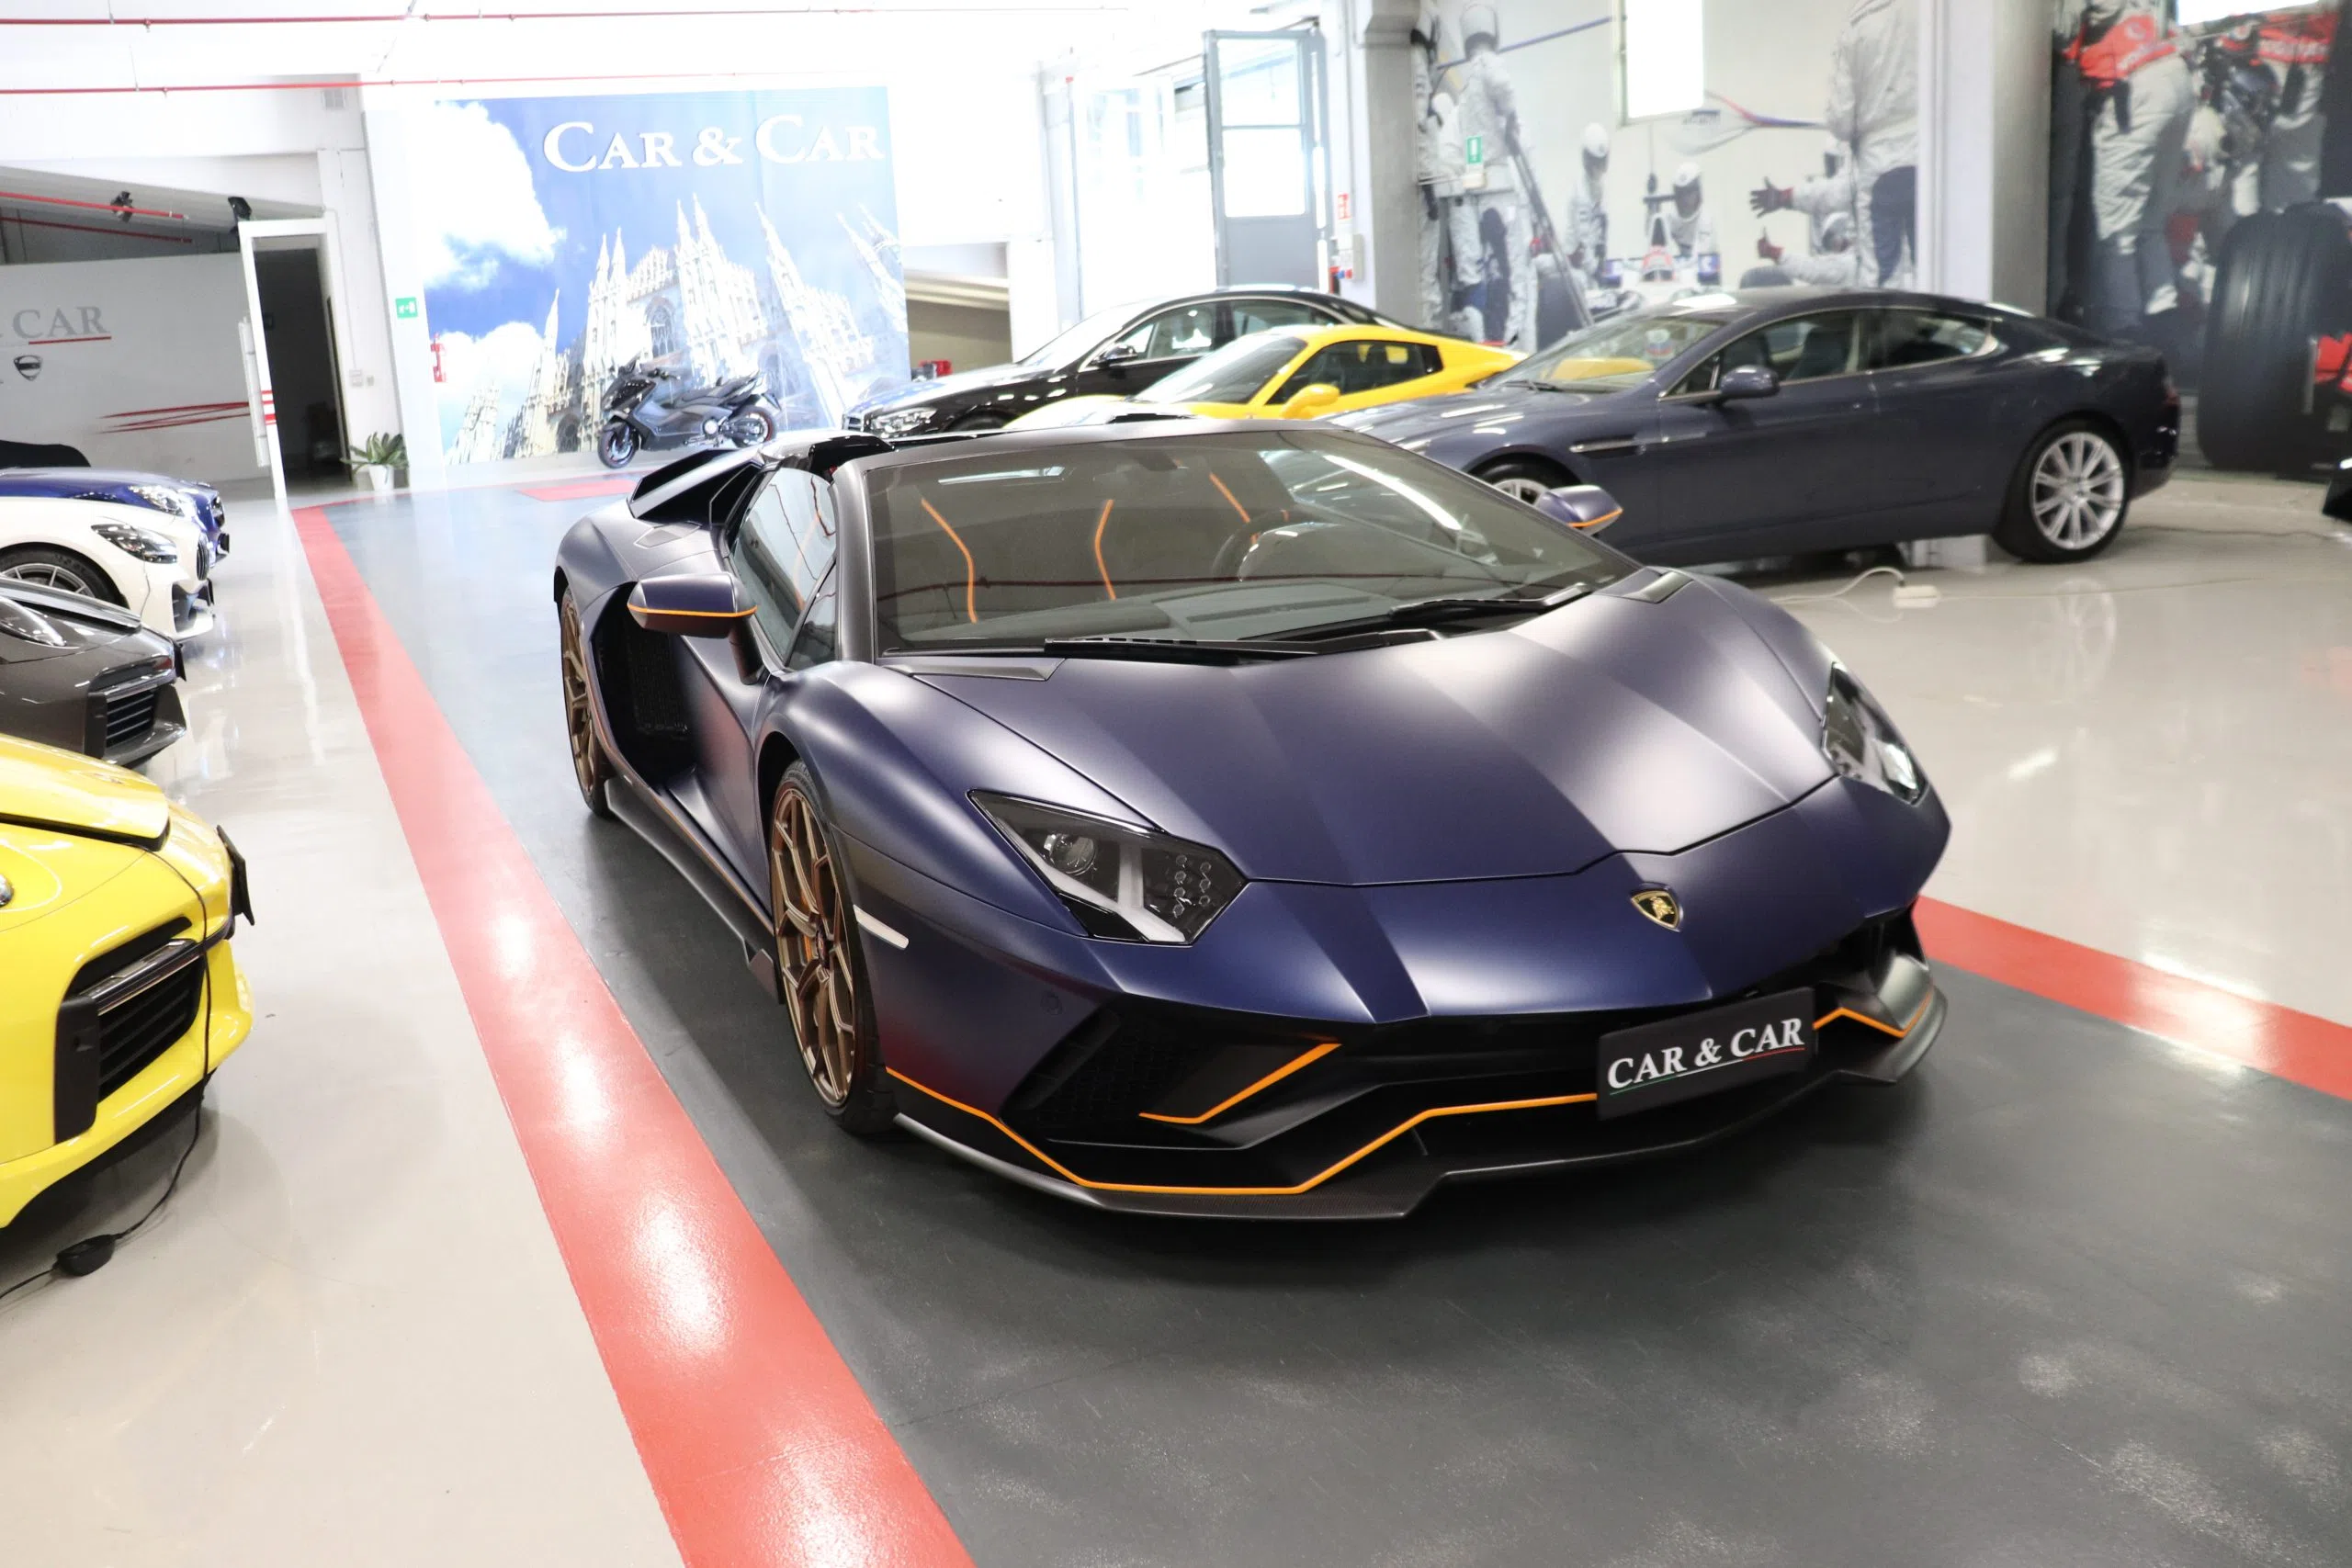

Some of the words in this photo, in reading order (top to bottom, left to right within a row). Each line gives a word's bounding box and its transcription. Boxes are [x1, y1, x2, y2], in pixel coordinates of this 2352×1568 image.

[691, 127, 743, 166] &
[12, 306, 109, 339] CAR
[1607, 1045, 1688, 1089] CAR
[1693, 1037, 1723, 1067] &
[1730, 1017, 1806, 1057] CAR
